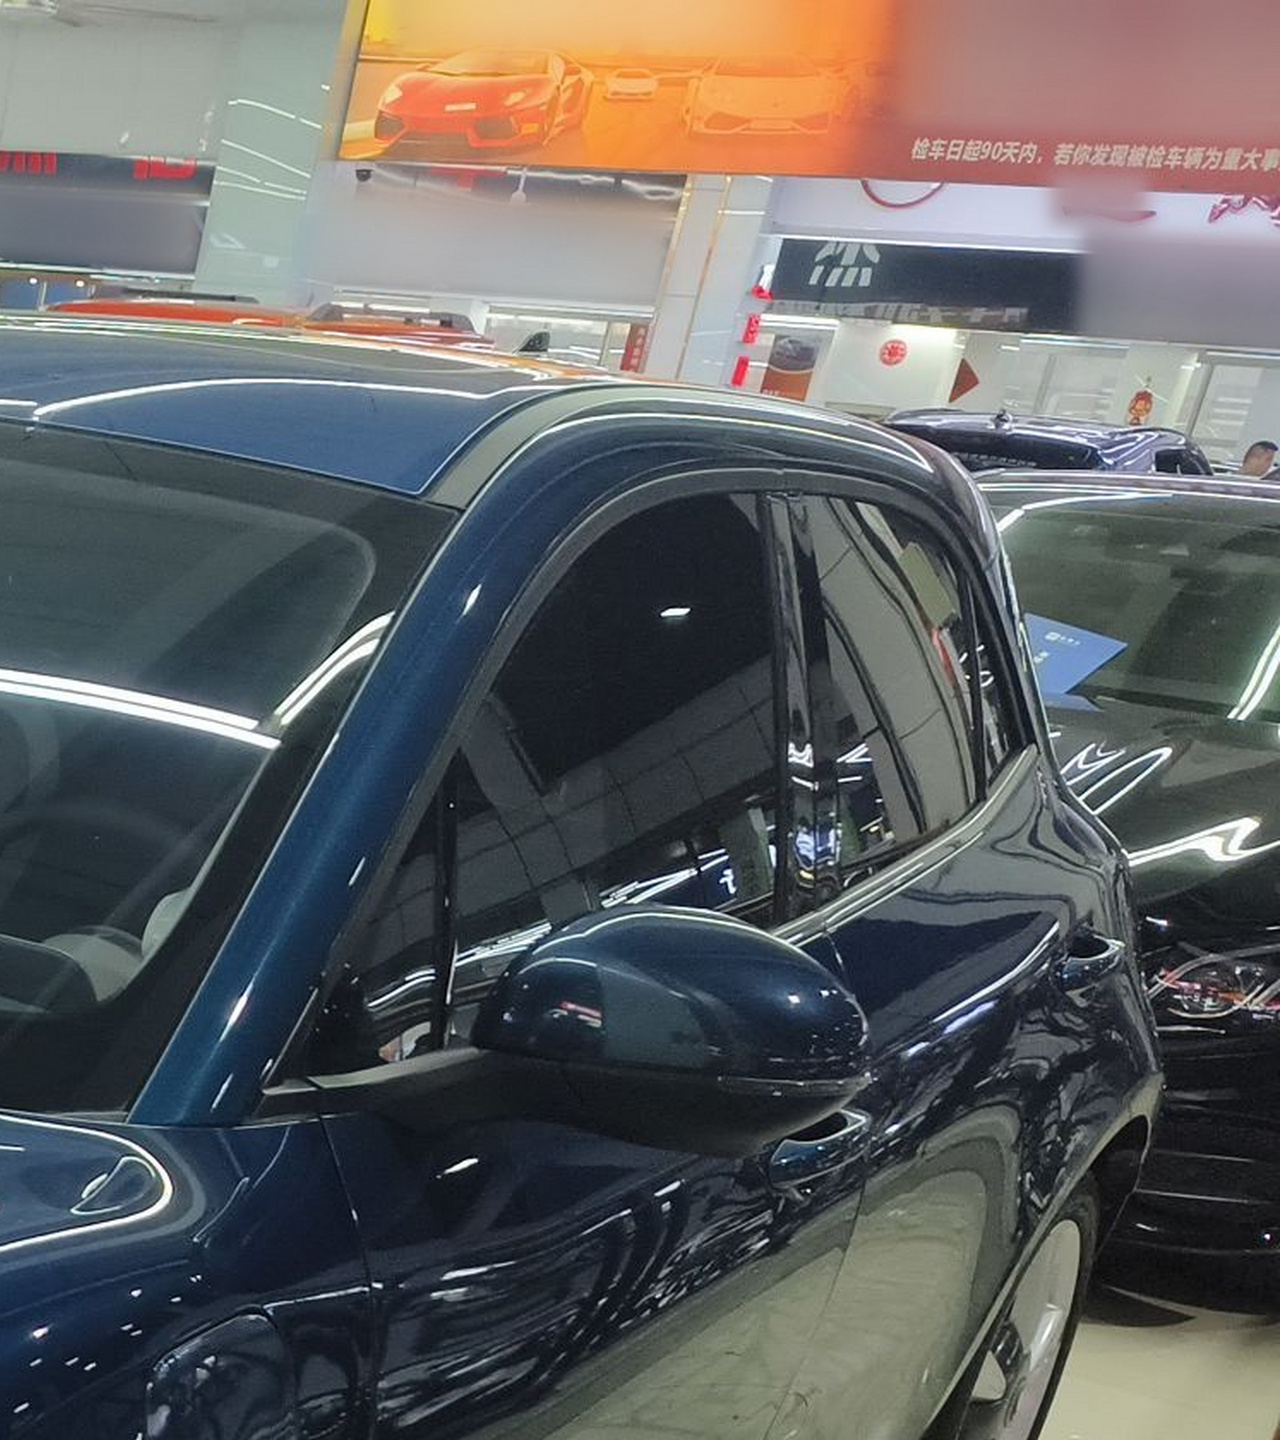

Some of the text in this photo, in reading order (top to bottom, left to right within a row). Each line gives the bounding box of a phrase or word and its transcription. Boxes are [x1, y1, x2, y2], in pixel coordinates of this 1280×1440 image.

[911, 137, 1280, 172] 检车日起90天内，若你发现被检车辆为重大事
